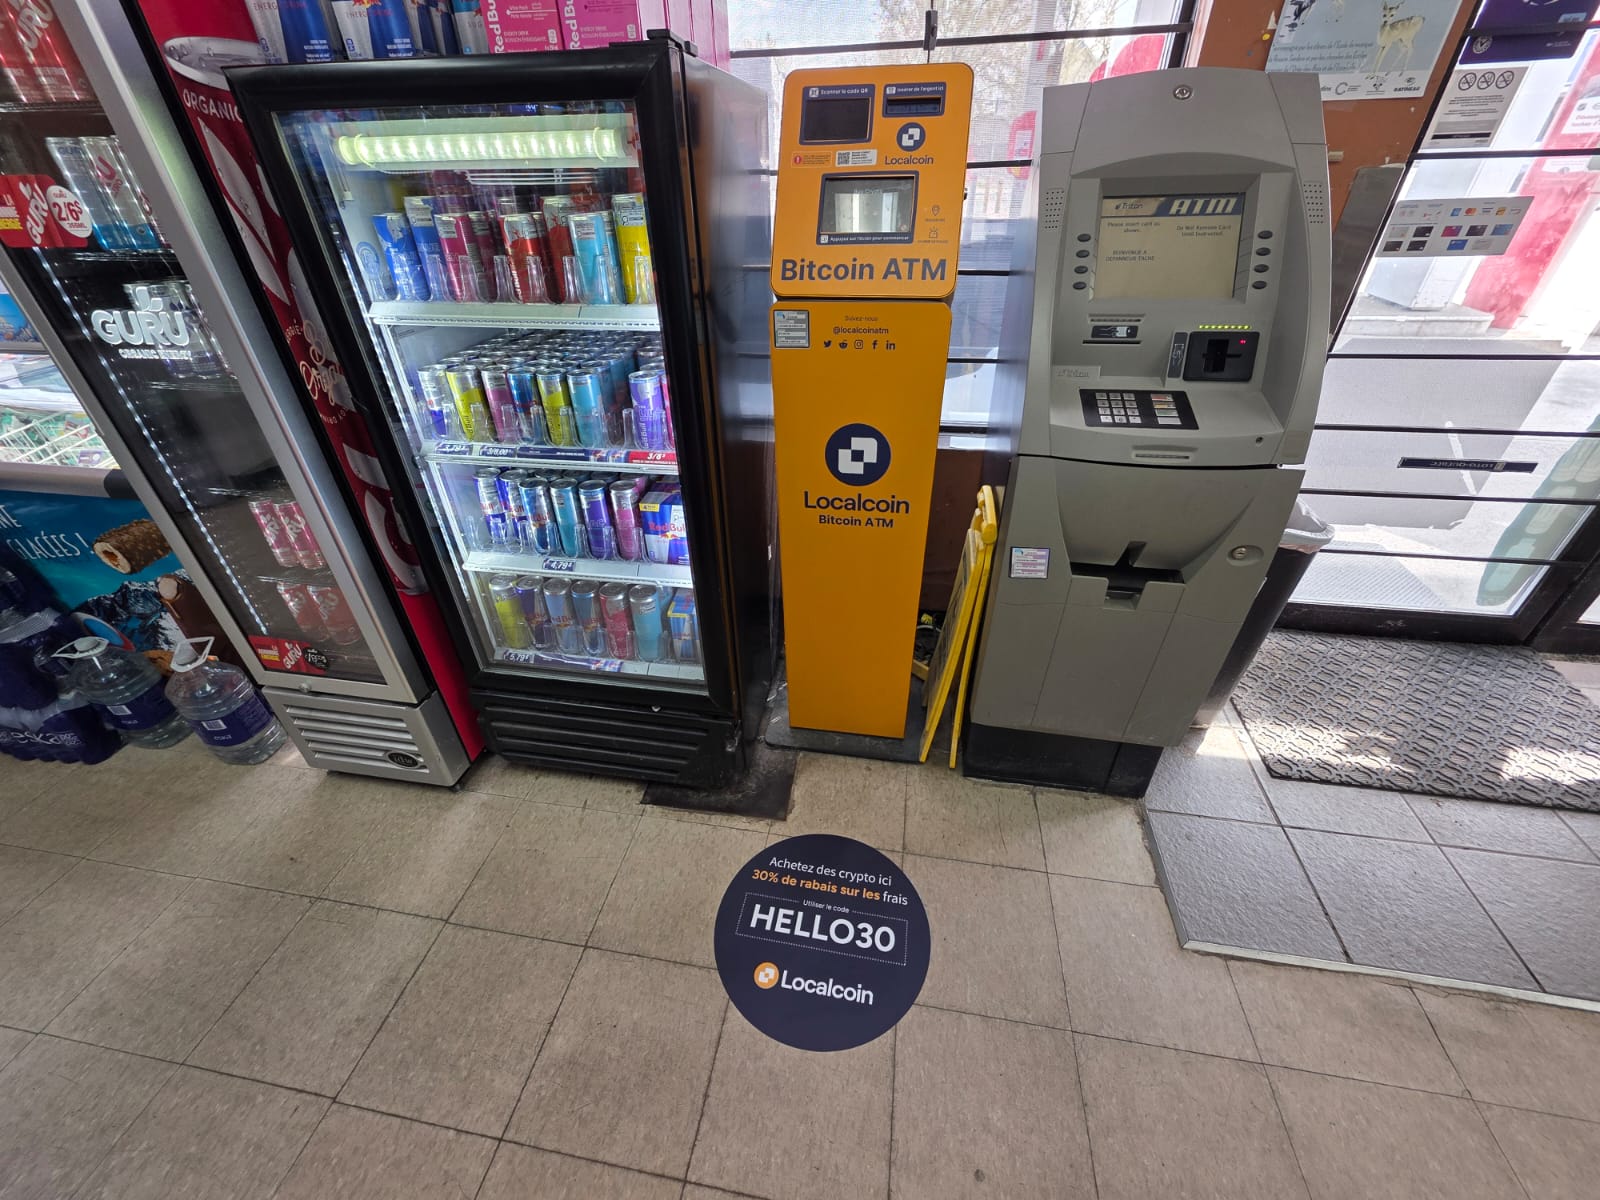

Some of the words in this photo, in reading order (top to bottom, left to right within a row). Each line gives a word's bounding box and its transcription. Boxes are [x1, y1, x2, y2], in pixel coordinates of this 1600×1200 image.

[487, 0, 499, 22] Bu
[489, 24, 504, 53] Red
[565, 20, 580, 50] Red
[885, 155, 934, 166] Localcoin
[26, 183, 49, 245] GURU
[1169, 198, 1238, 215] ATM
[781, 257, 875, 281] Bitcoin
[881, 257, 947, 281] ATM
[91, 310, 190, 346] GURU
[833, 326, 889, 335] @localcoinatm
[804, 491, 910, 514] Localcoin
[670, 523, 686, 532] Bul
[819, 515, 861, 527] Bitcoin
[865, 517, 893, 528] ATM
[6, 530, 81, 560] GLACÉES
[283, 643, 302, 669] GURU
[769, 856, 814, 873] Achetez
[816, 864, 836, 877] des
[838, 869, 876, 884] crypto
[878, 873, 892, 887] ici
[752, 869, 778, 883] 30%
[781, 872, 797, 886] de
[800, 877, 837, 893] rabais
[840, 885, 860, 898] sur
[862, 887, 881, 900] les
[883, 891, 908, 906] frais
[803, 899, 825, 909] Utiliser
[825, 902, 832, 910] le
[833, 904, 850, 914] code
[750, 904, 896, 952] HELLO30
[780, 970, 874, 1005] Localcoin
